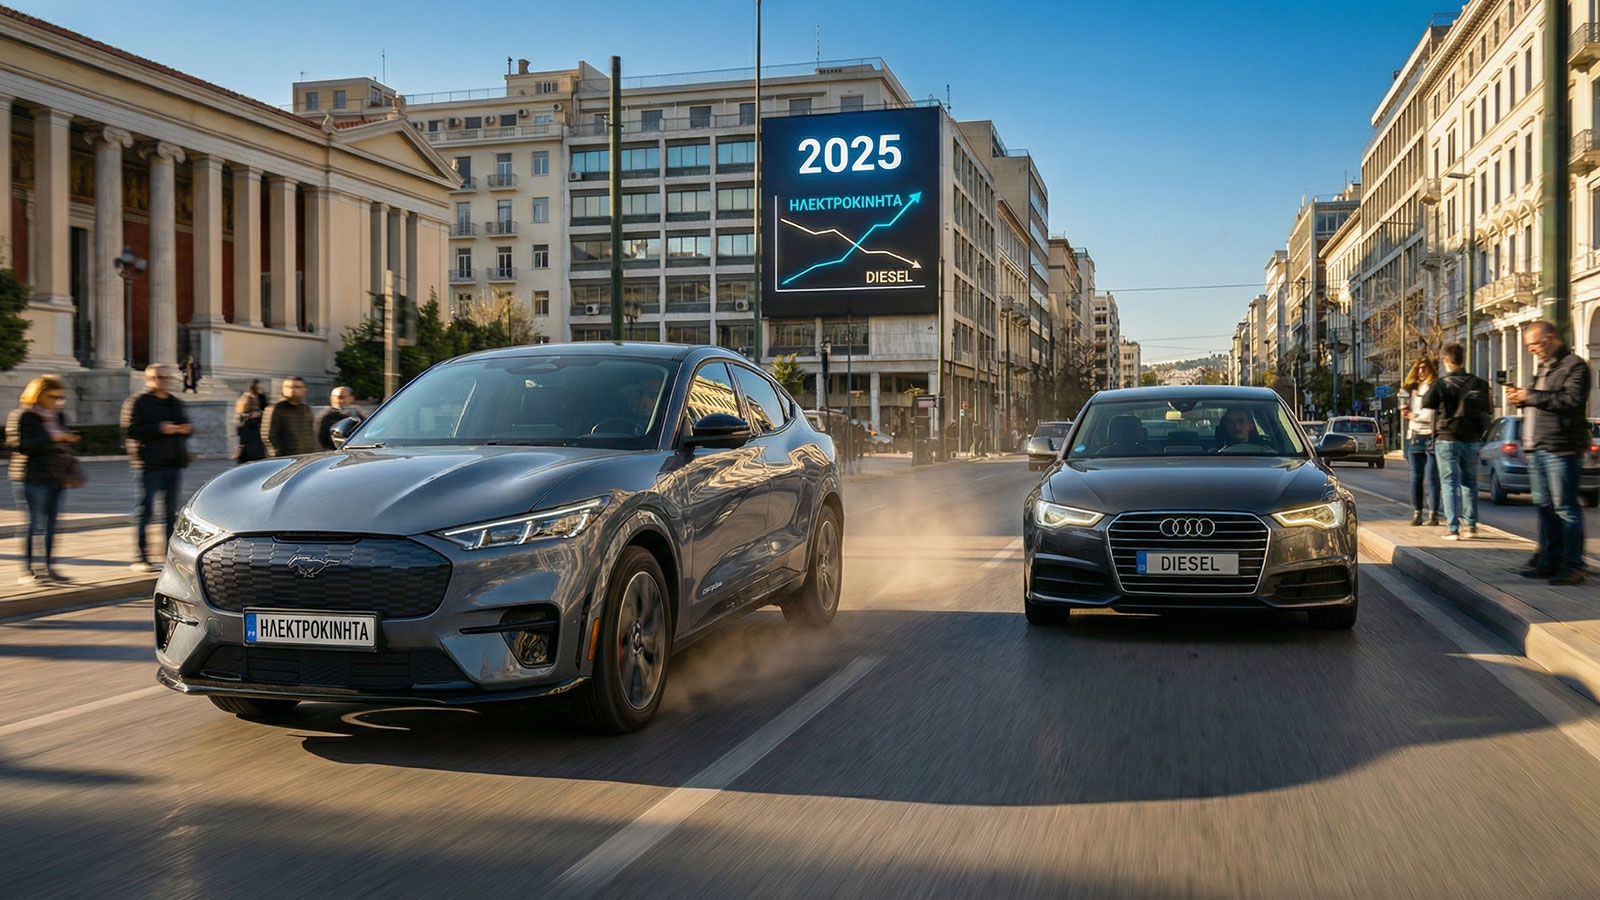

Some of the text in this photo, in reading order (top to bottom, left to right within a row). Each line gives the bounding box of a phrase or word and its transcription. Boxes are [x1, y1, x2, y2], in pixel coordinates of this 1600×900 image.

[798, 134, 902, 174] 2025
[789, 194, 902, 211] ΗΛΕΚΤΡΟΚΙΝΗΤΑ
[866, 270, 913, 283] DIESEL
[1161, 556, 1220, 571] DIESEL
[260, 618, 369, 640] ΗΛΕΚΤΡΟΚΙΝΗΤΑ
